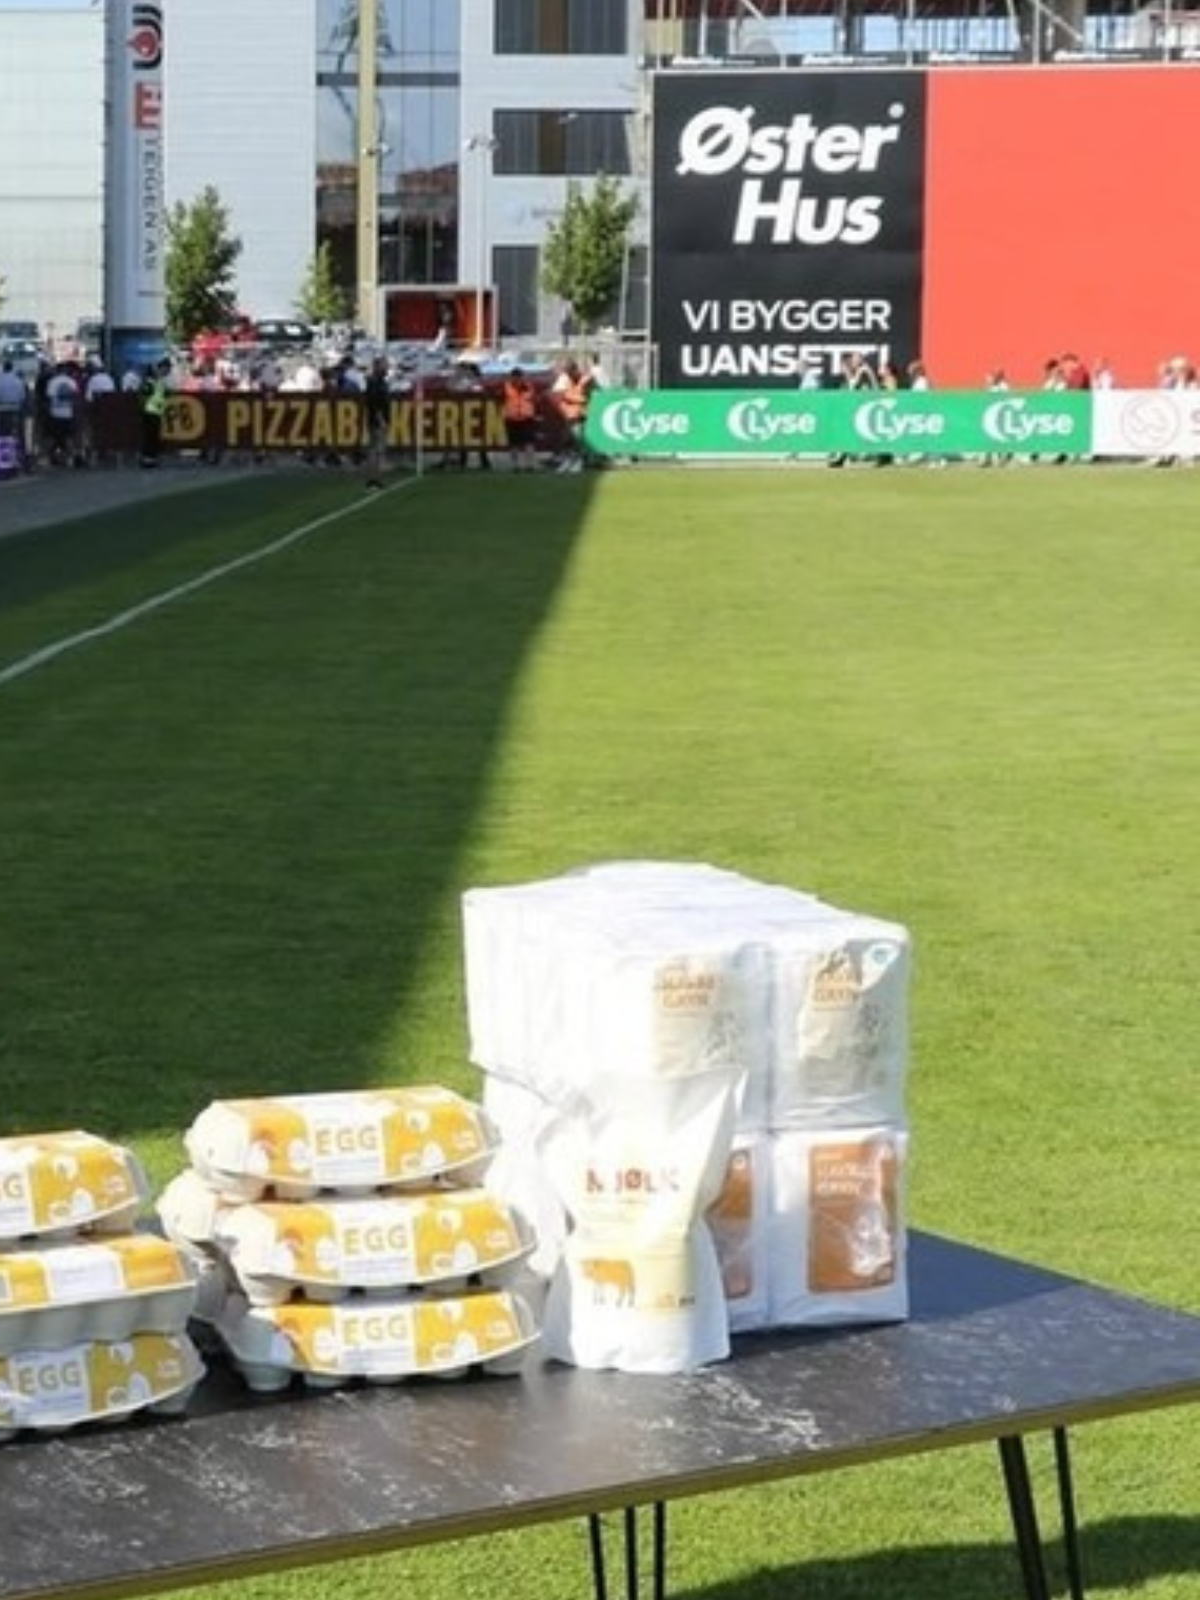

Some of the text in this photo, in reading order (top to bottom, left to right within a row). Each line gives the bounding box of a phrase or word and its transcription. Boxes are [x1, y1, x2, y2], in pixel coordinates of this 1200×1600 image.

[675, 103, 898, 175] Øster
[733, 178, 884, 244] Hus
[682, 299, 892, 332] VI BYGGER
[621, 409, 690, 442] Lyse
[746, 409, 816, 442] Lyse
[875, 409, 945, 442] Lyse
[1003, 409, 1075, 442] Lyse
[314, 1124, 378, 1156] EGG
[342, 1225, 409, 1256] EGG
[342, 1313, 410, 1345] EGG
[16, 1360, 81, 1395] EGG
